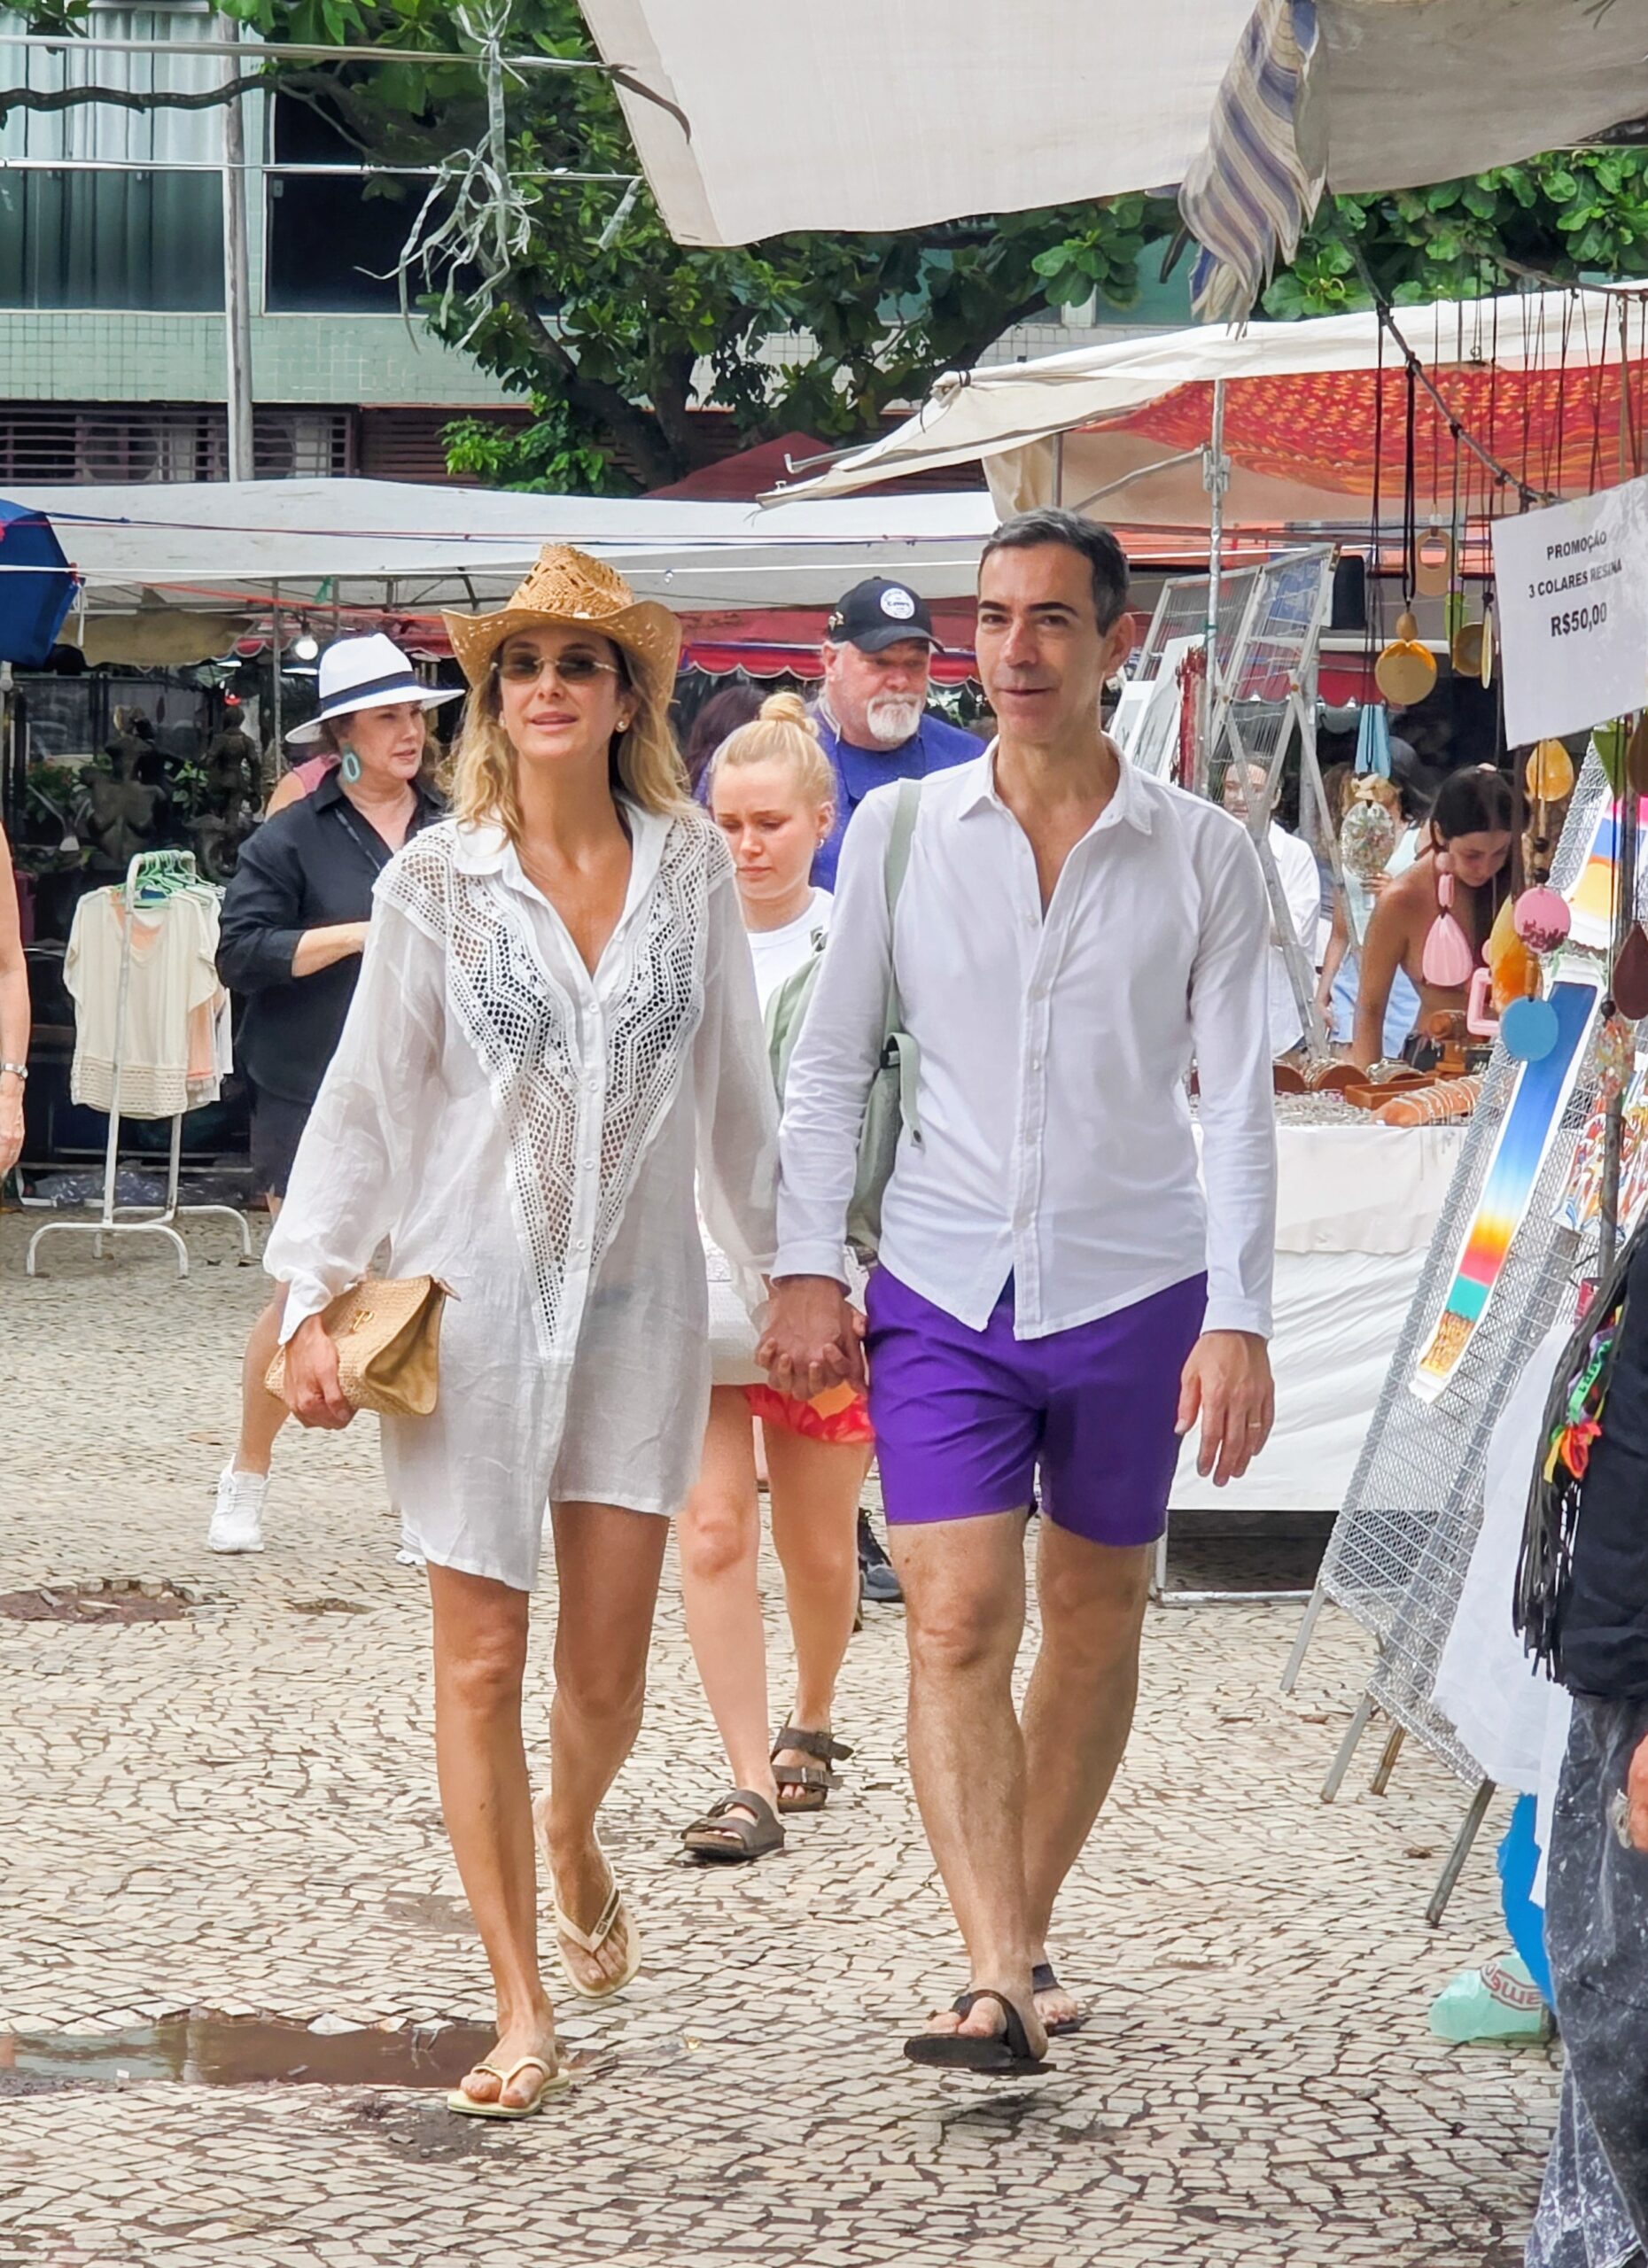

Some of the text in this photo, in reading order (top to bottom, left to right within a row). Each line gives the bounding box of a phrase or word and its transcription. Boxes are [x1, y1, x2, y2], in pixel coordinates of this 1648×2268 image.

[1546, 530, 1606, 560] PROMOÇÃO
[1528, 557, 1622, 599] 3 COLARES RESINA
[1551, 602, 1607, 637] R$50,00
